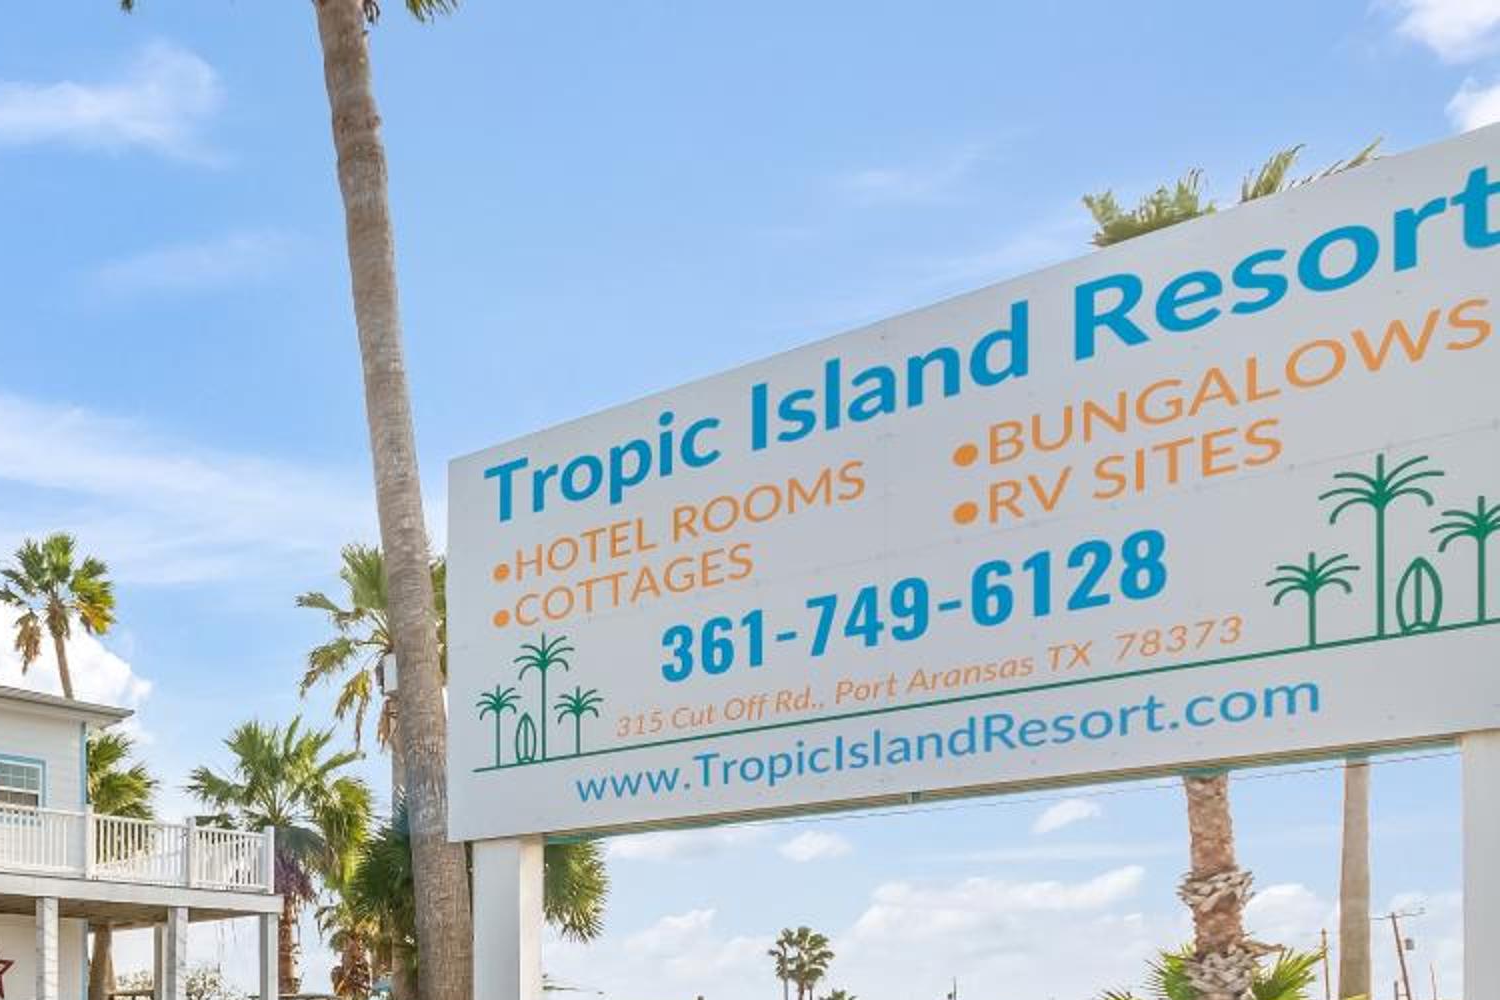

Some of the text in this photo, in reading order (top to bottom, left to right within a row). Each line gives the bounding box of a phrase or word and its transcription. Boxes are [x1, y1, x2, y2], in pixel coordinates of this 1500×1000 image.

[484, 166, 1500, 523] Tropic Island Resort
[987, 297, 1494, 468] BUNGALOWS
[515, 459, 866, 582] HOTEL ROOMS
[986, 416, 1285, 525] RV SITES
[515, 541, 755, 626] COTTAGES
[661, 528, 1168, 683] 361-749-6128
[617, 710, 662, 737] 315
[671, 702, 715, 729] Cut
[724, 694, 770, 722] Off
[835, 671, 898, 704] Port
[905, 654, 1035, 694] Aransas
[1047, 639, 1093, 672] TX
[1114, 615, 1243, 664] 78373
[578, 683, 1319, 801] www.TropicIslandResort.com
